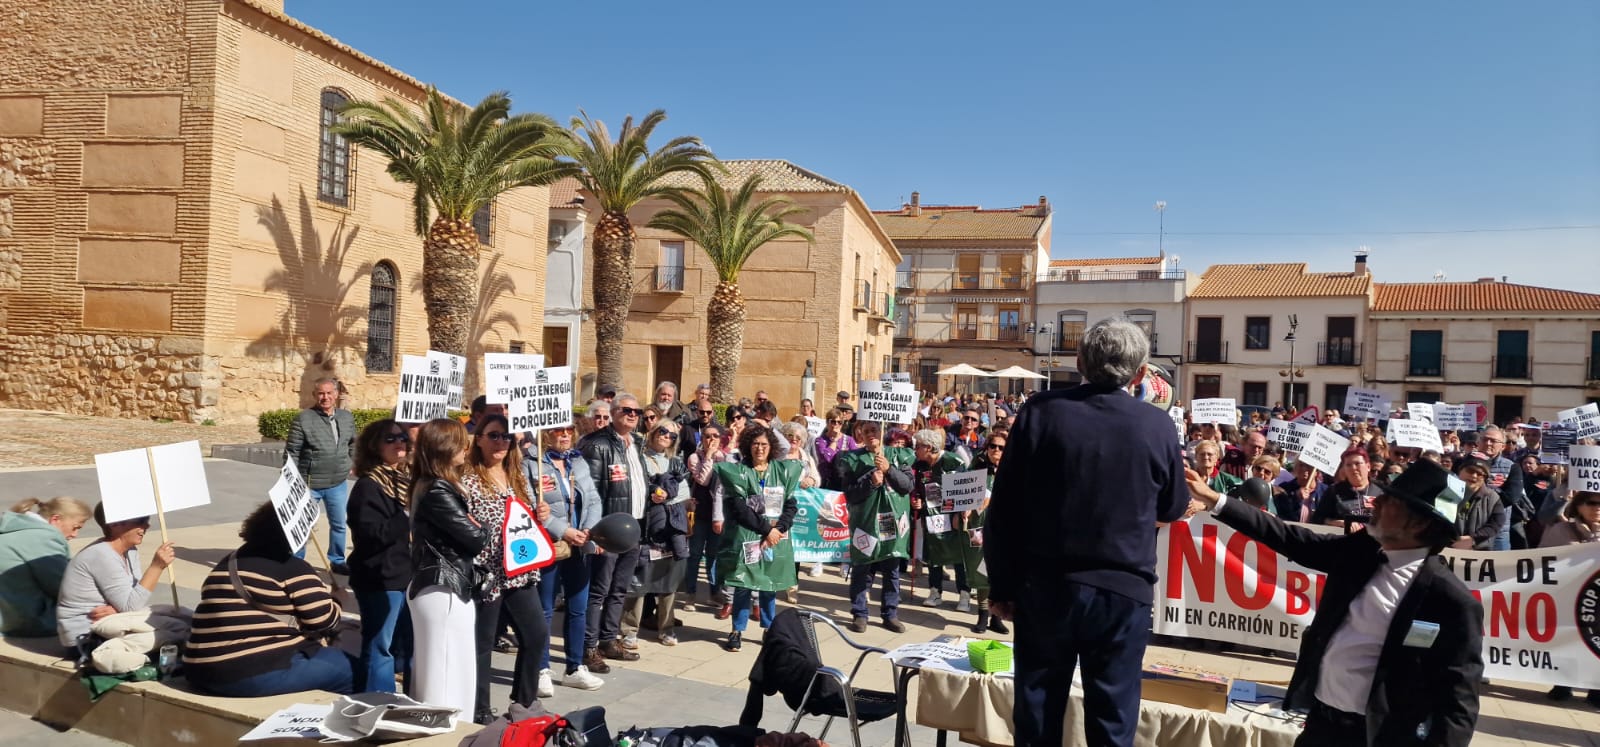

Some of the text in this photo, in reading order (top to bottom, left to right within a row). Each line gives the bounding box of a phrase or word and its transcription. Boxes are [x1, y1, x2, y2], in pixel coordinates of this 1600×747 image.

[401, 373, 413, 393] NI
[414, 374, 425, 394] EN
[510, 380, 571, 402] ¡NO ES ENERGÍA
[527, 397, 559, 413] ES UNA
[860, 391, 913, 403] VAMOS A GANAR
[401, 400, 414, 420] NI
[414, 400, 425, 420] EN
[863, 401, 907, 412] LA CONSULTA
[512, 409, 570, 430] PORQUERÍA!
[869, 412, 900, 421] POPULAR
[1571, 458, 1600, 468] VAMO
[1578, 469, 1589, 478] LA
[1587, 481, 1600, 491] PO
[823, 530, 849, 538] BIOM
[796, 539, 806, 548] LA
[1166, 520, 1328, 616] NO BI
[1450, 556, 1559, 586] TA DE
[1581, 589, 1599, 622] STOP
[1165, 606, 1299, 640] NI EN CARRIÓN DE
[1489, 646, 1559, 671] DE CVA.
